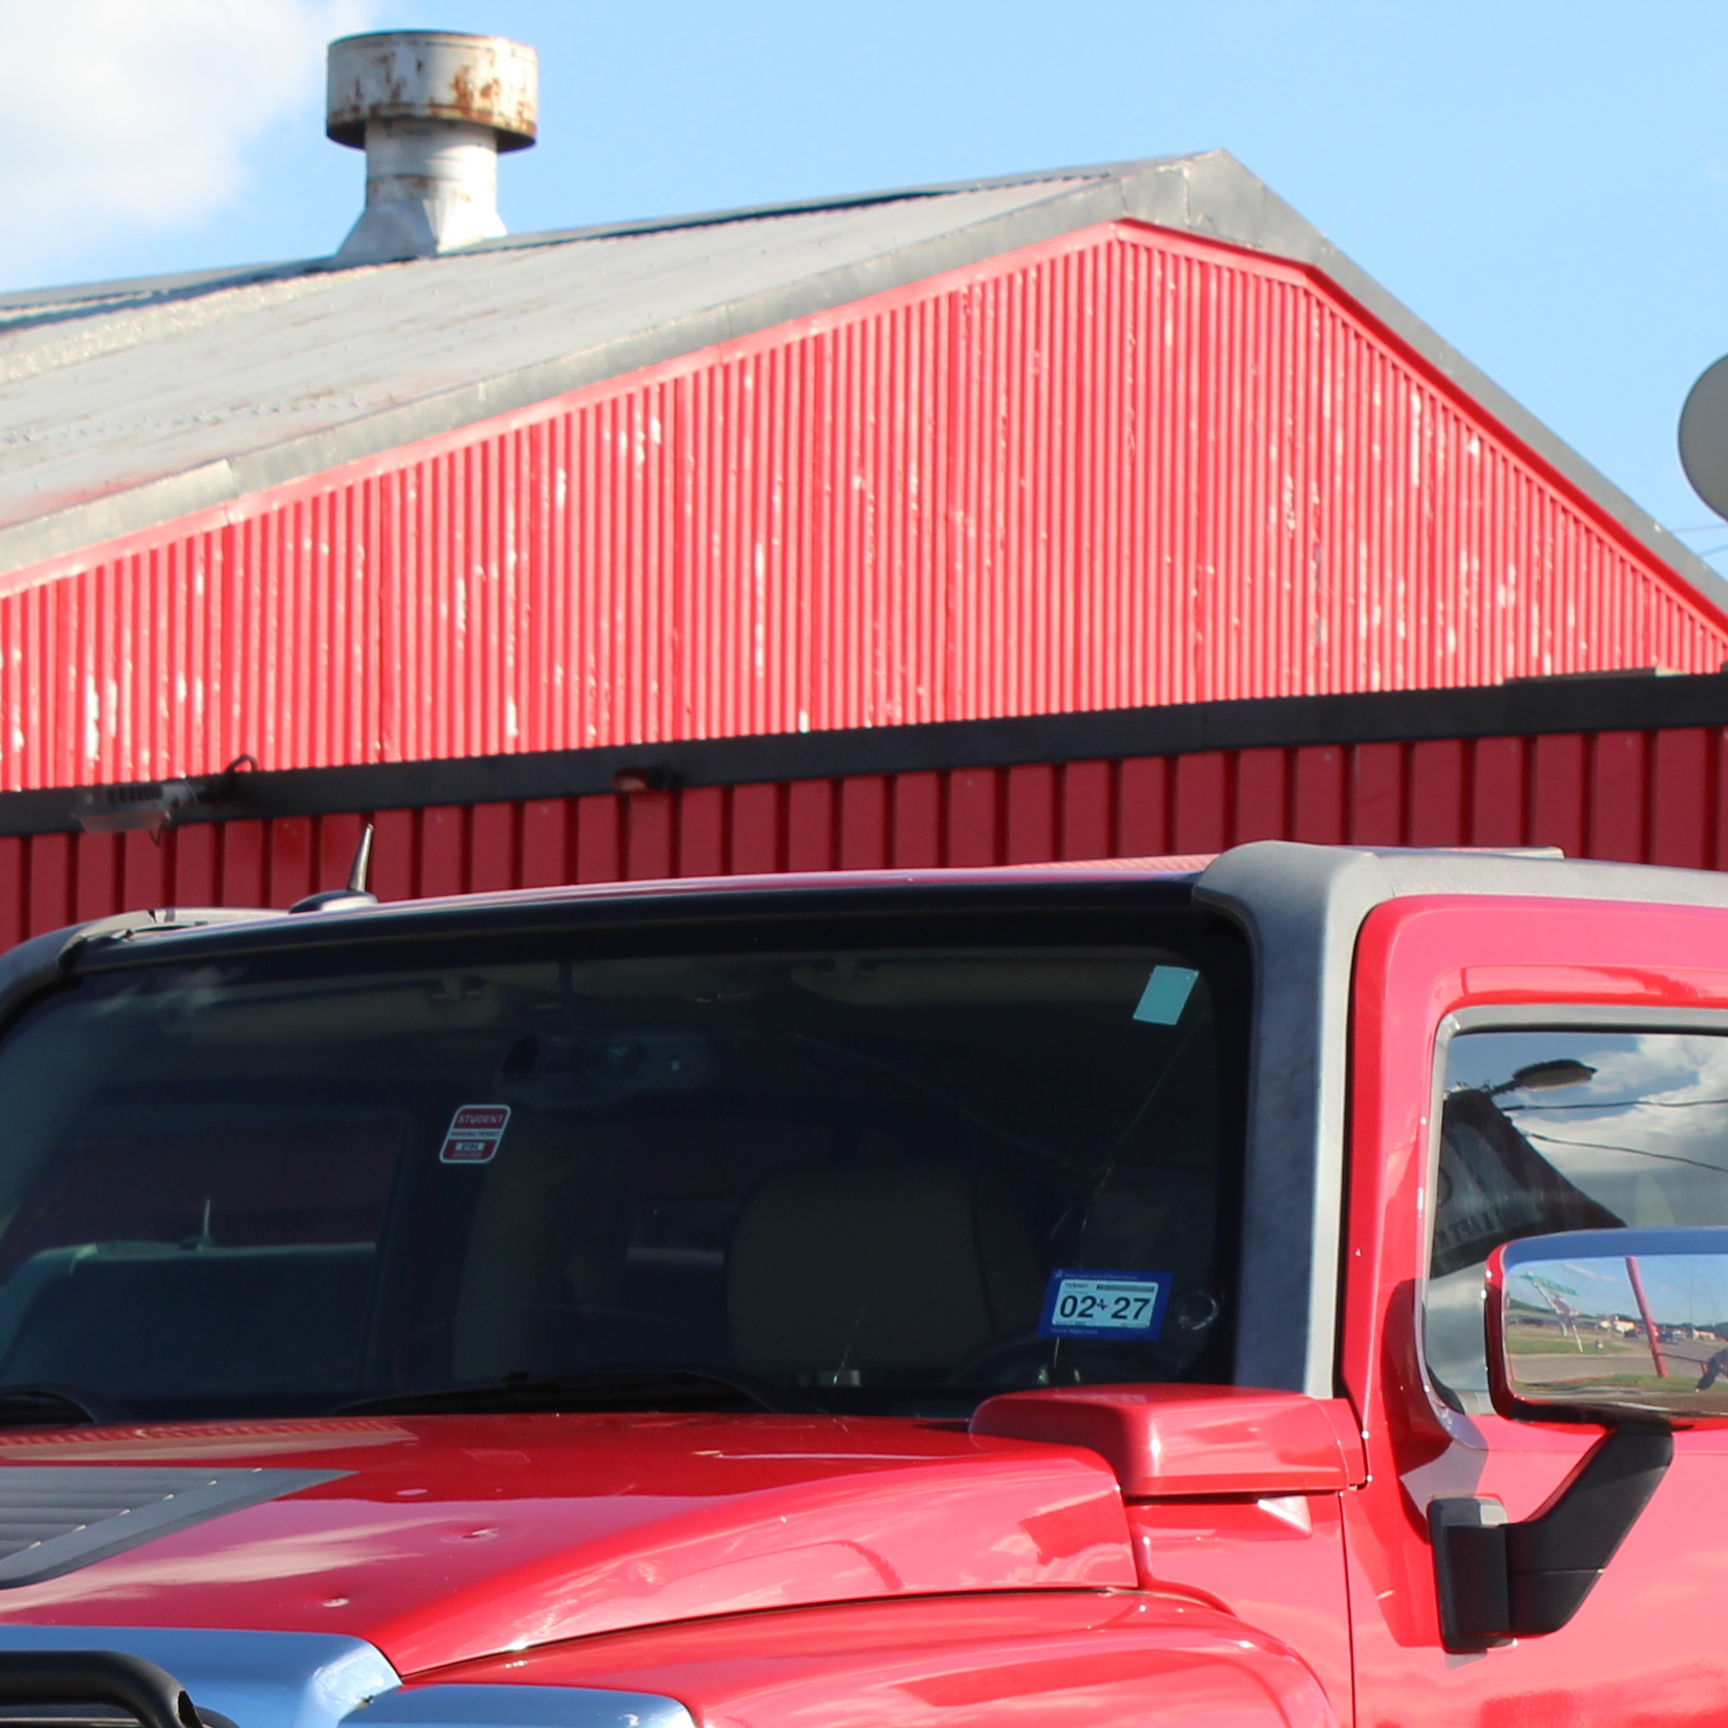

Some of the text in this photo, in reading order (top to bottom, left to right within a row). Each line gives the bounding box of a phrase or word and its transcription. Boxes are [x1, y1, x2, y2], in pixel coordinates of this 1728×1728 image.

[457, 1114, 504, 1124] STUDENT
[1060, 1295, 1151, 1320] 02 27
